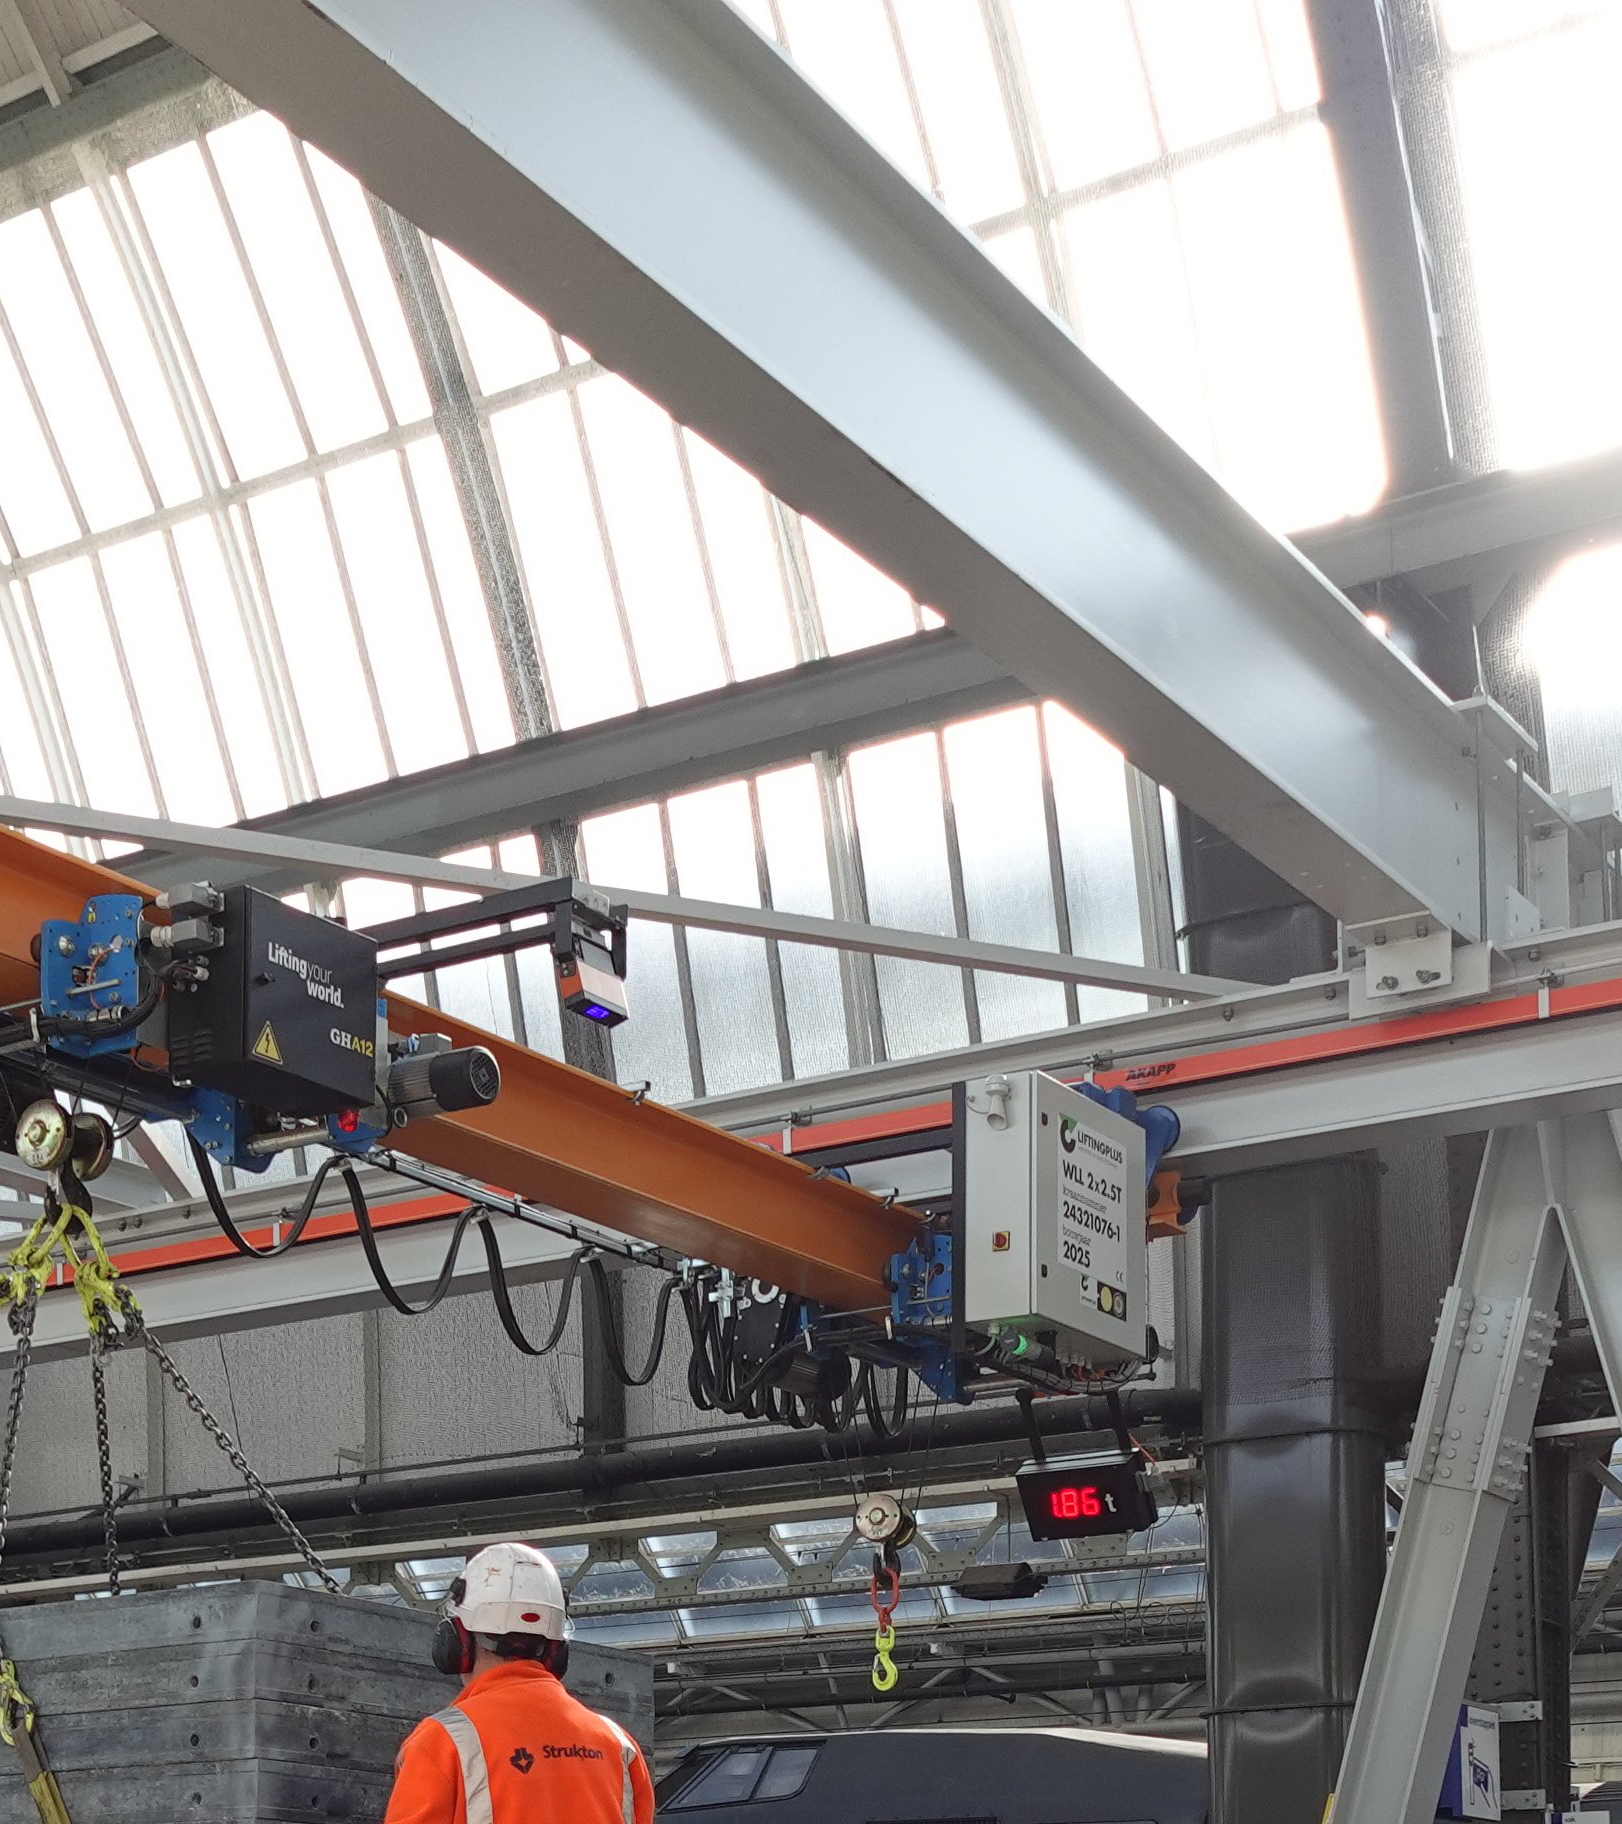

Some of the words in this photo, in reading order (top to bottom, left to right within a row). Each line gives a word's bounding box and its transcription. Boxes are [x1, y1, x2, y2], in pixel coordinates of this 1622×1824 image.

[306, 980, 345, 1009] world.
[330, 1028, 374, 1058] GHA12
[1078, 1130, 1123, 1164] LIFTINGPLUS
[1063, 1160, 1084, 1186] WLL
[1063, 1200, 1121, 1243] 24321076-1
[1063, 1240, 1091, 1268] 2025
[1105, 1493, 1117, 1512] t
[543, 1744, 604, 1760] Strukton
